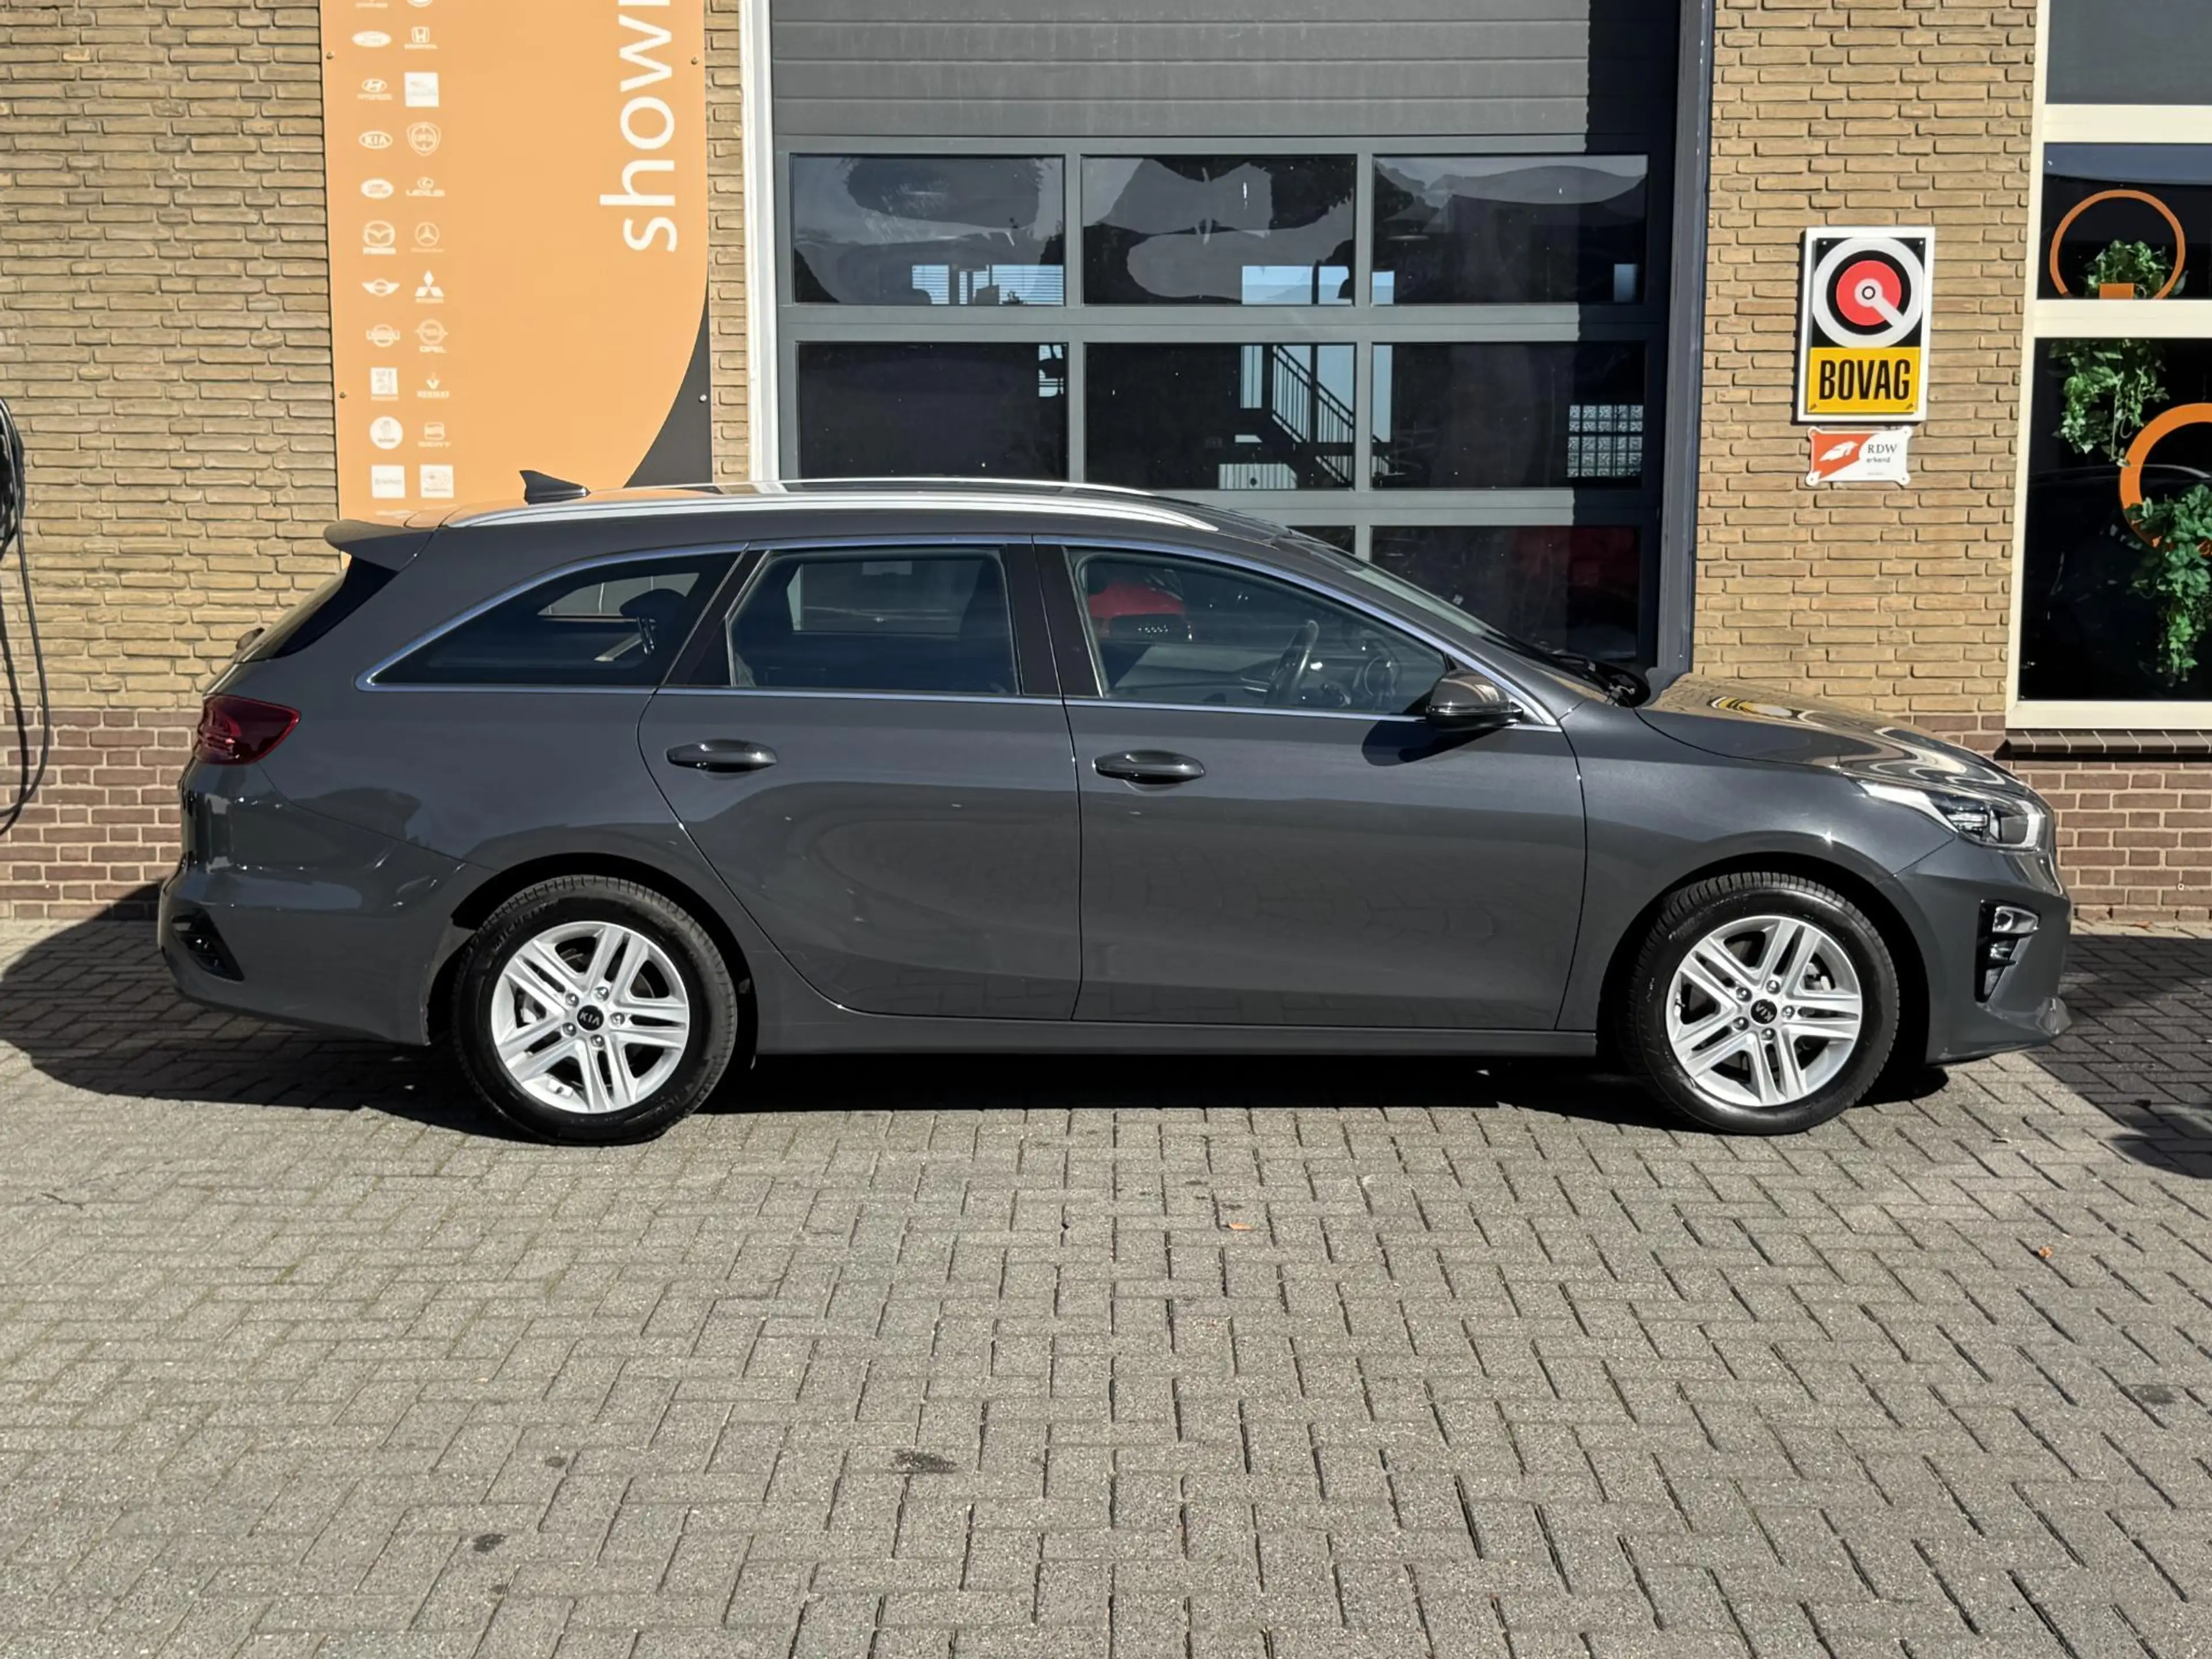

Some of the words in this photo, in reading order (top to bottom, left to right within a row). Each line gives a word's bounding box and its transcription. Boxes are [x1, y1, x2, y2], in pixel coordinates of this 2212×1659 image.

[599, 0, 677, 252] show
[366, 135, 388, 145] KIA
[1819, 359, 1911, 401] BOVAG
[1867, 443, 1898, 454] RDW
[578, 1012, 600, 1027] KIA
[1753, 1003, 1775, 1021] KIA
